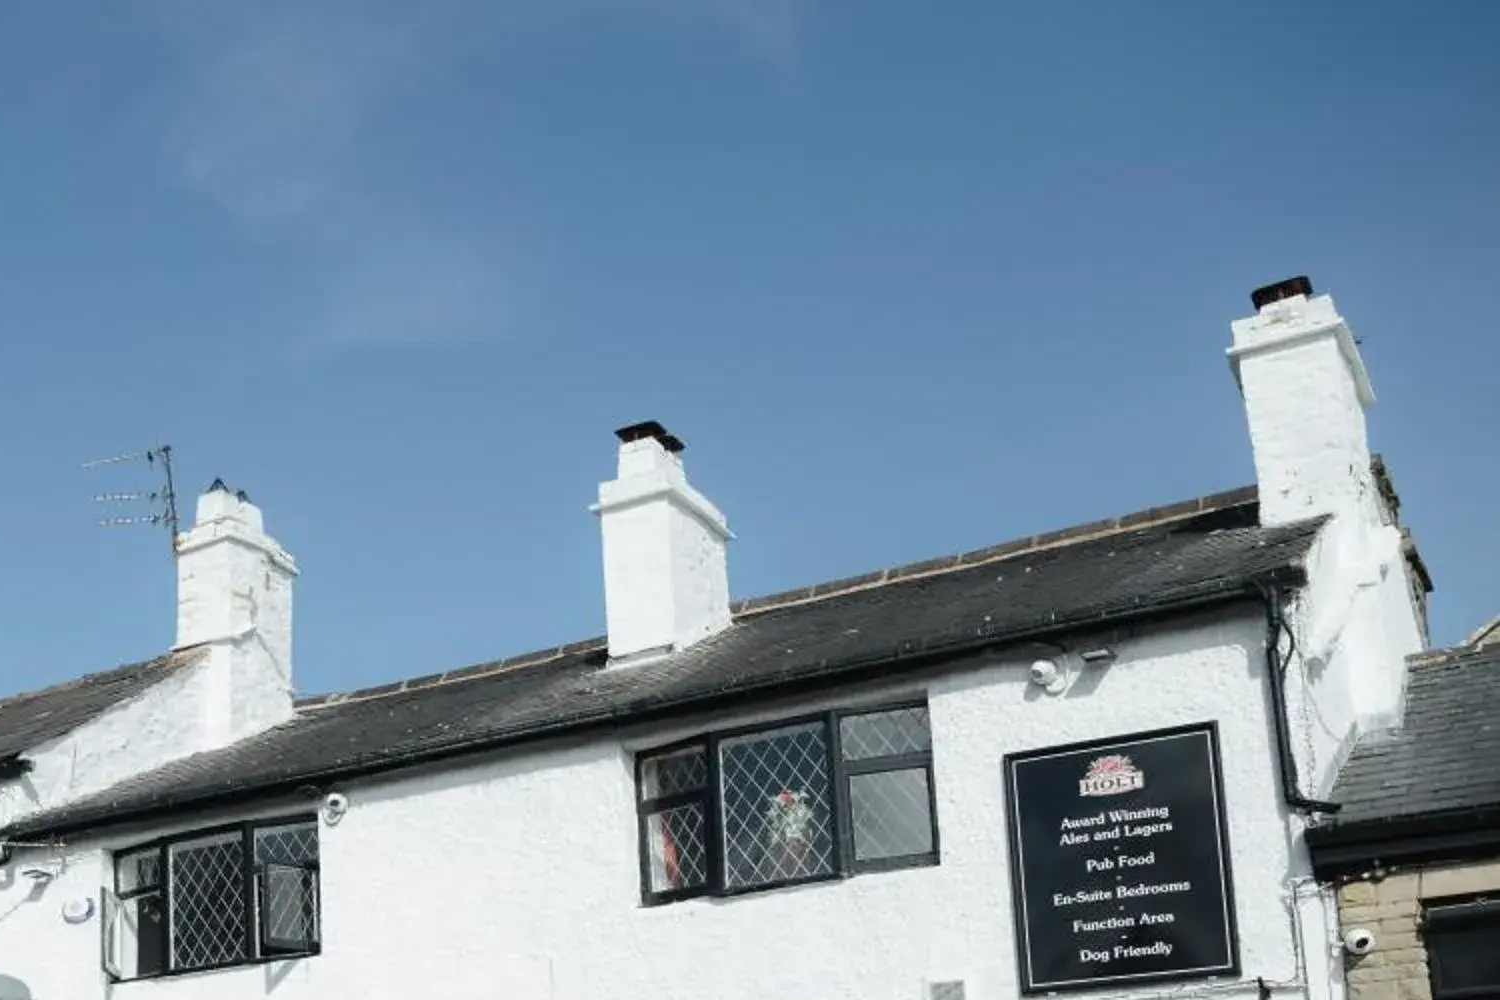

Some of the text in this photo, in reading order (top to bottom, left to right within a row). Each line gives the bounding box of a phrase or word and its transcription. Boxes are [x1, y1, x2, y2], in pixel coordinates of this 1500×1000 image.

[1061, 807, 1169, 830] Award Winning
[1060, 822, 1173, 846] Ales and Lagers
[1086, 851, 1155, 872] Pub Food
[1053, 881, 1191, 906] En-Suite Bedrooms
[1073, 912, 1175, 933] Function Area
[1080, 941, 1173, 962] Dog Friendly
